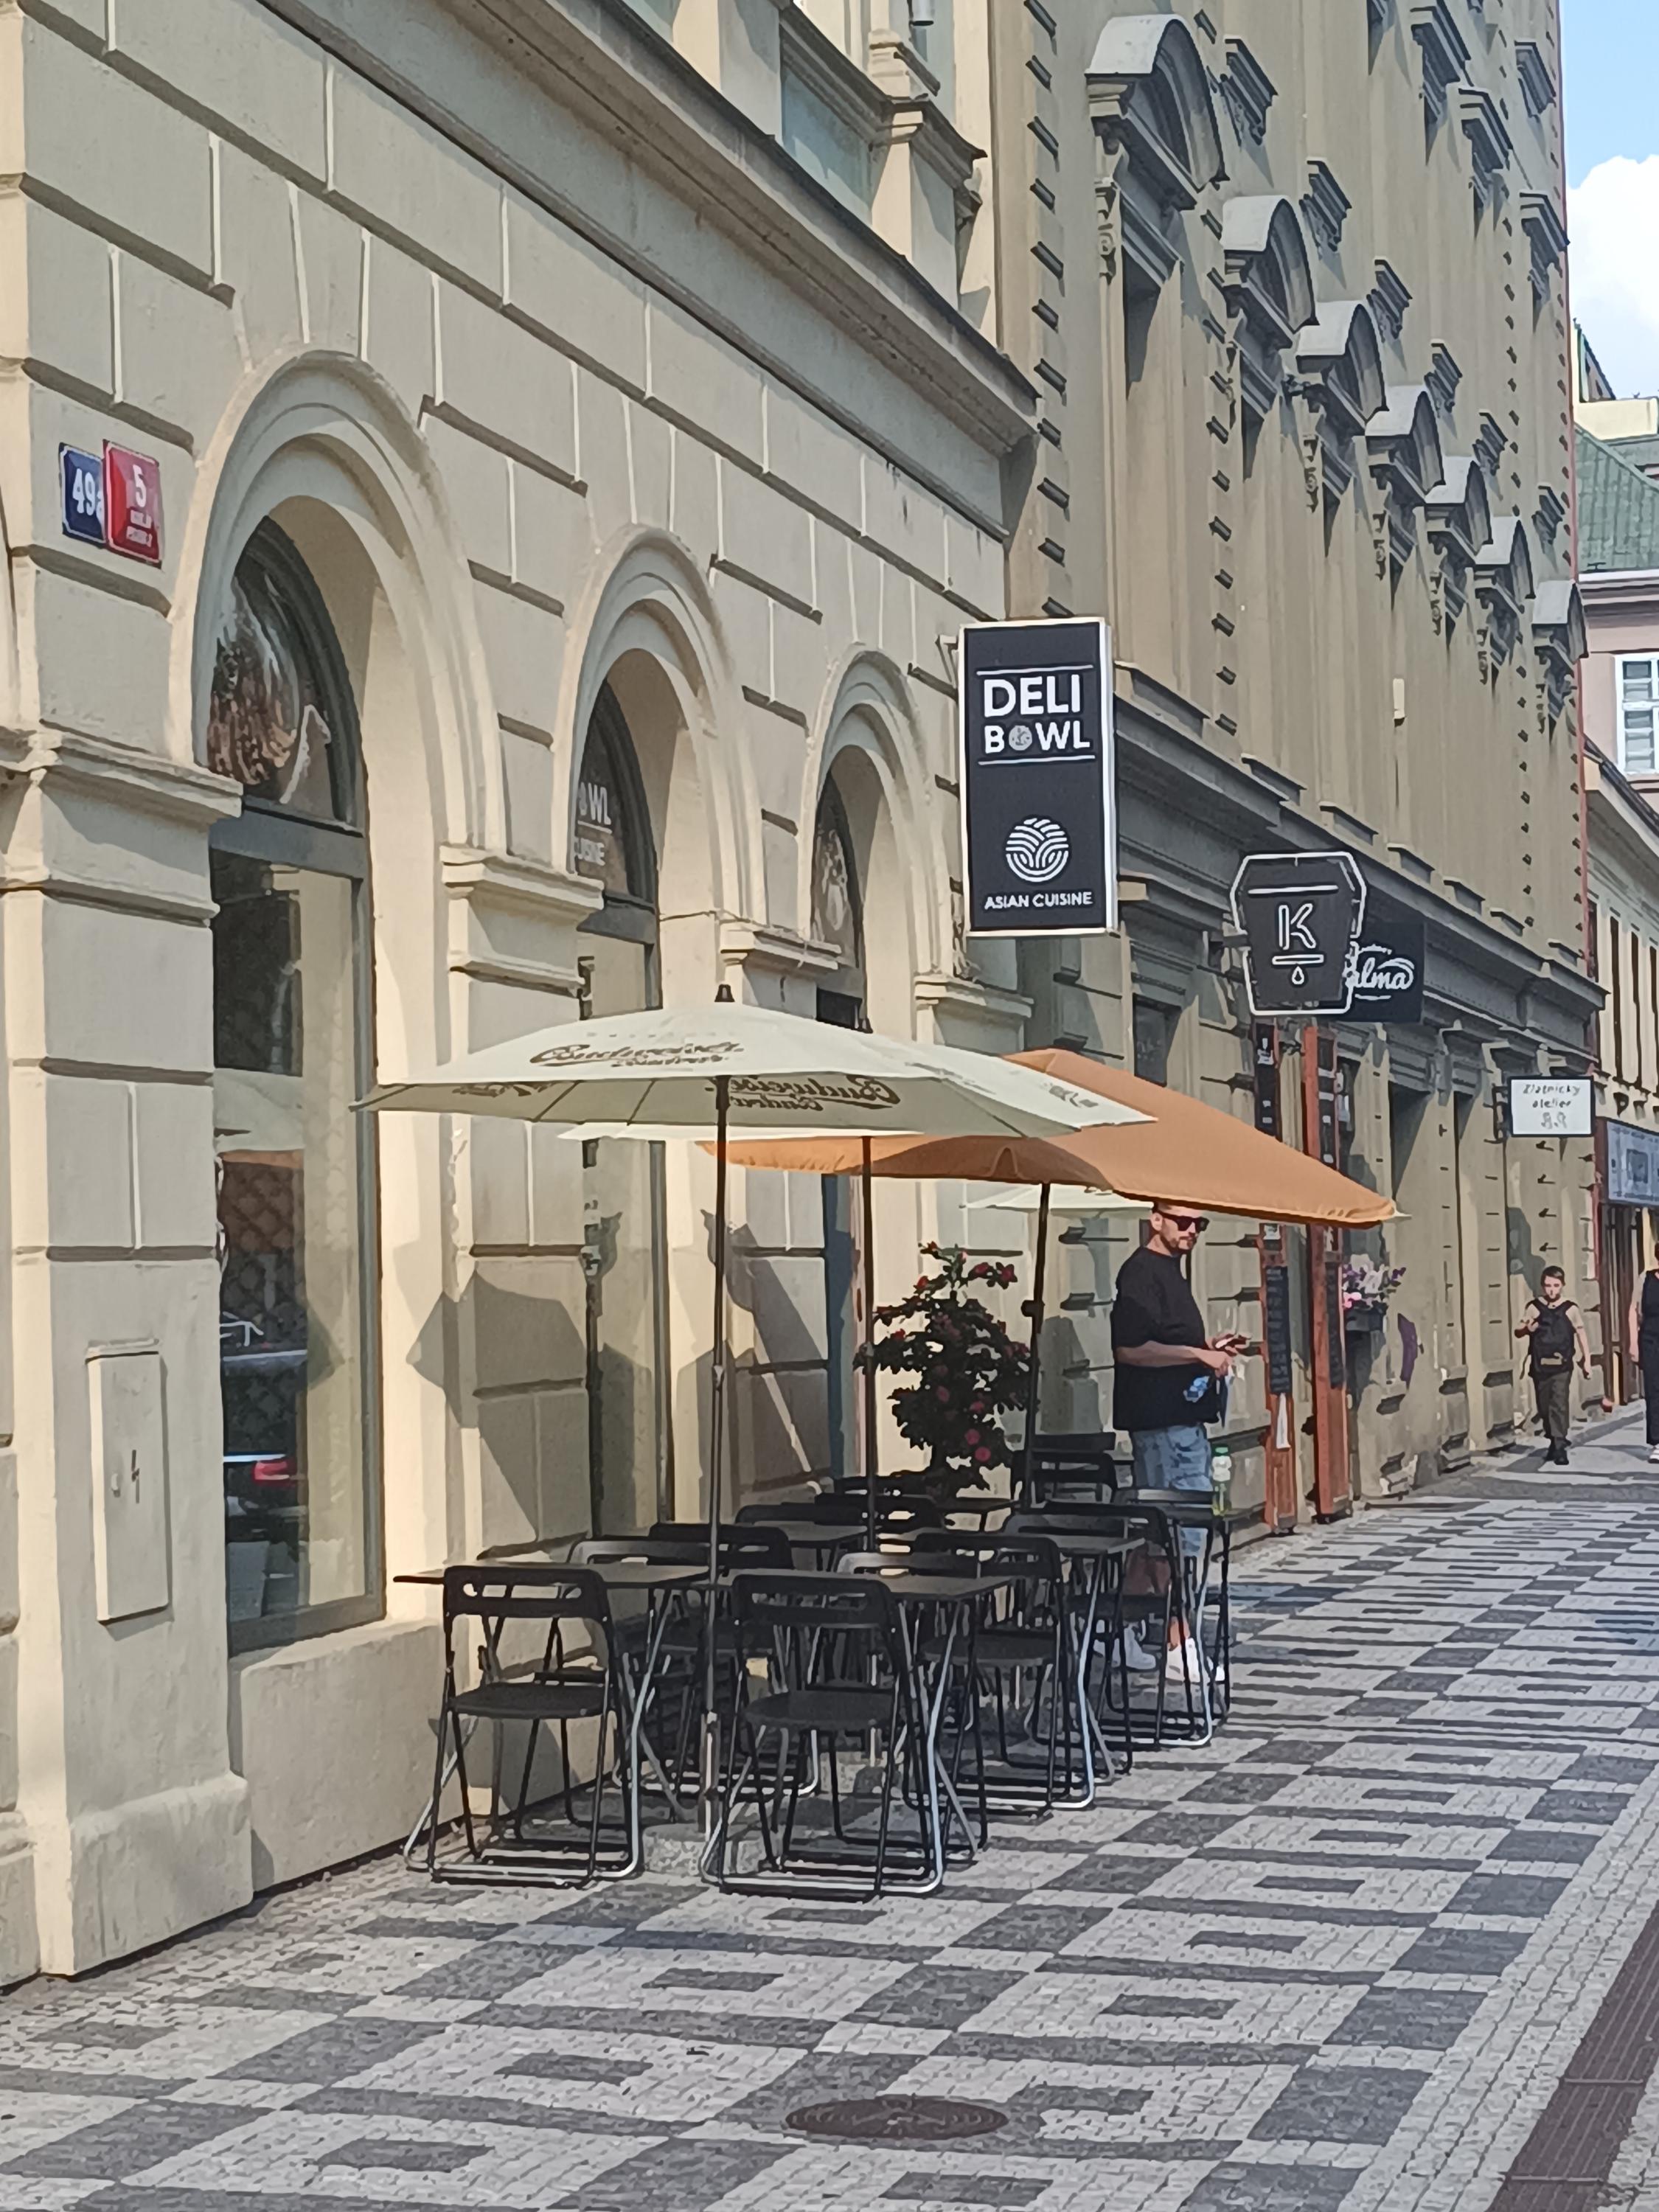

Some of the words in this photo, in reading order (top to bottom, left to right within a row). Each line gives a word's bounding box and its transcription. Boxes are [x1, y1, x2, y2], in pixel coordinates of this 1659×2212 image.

[132, 464, 147, 508] 5
[984, 674, 1081, 717] DELI
[984, 720, 1091, 754] BOWL
[984, 894, 1030, 911] ASIAN
[1032, 891, 1093, 908] CUISINE
[1279, 903, 1317, 950] K
